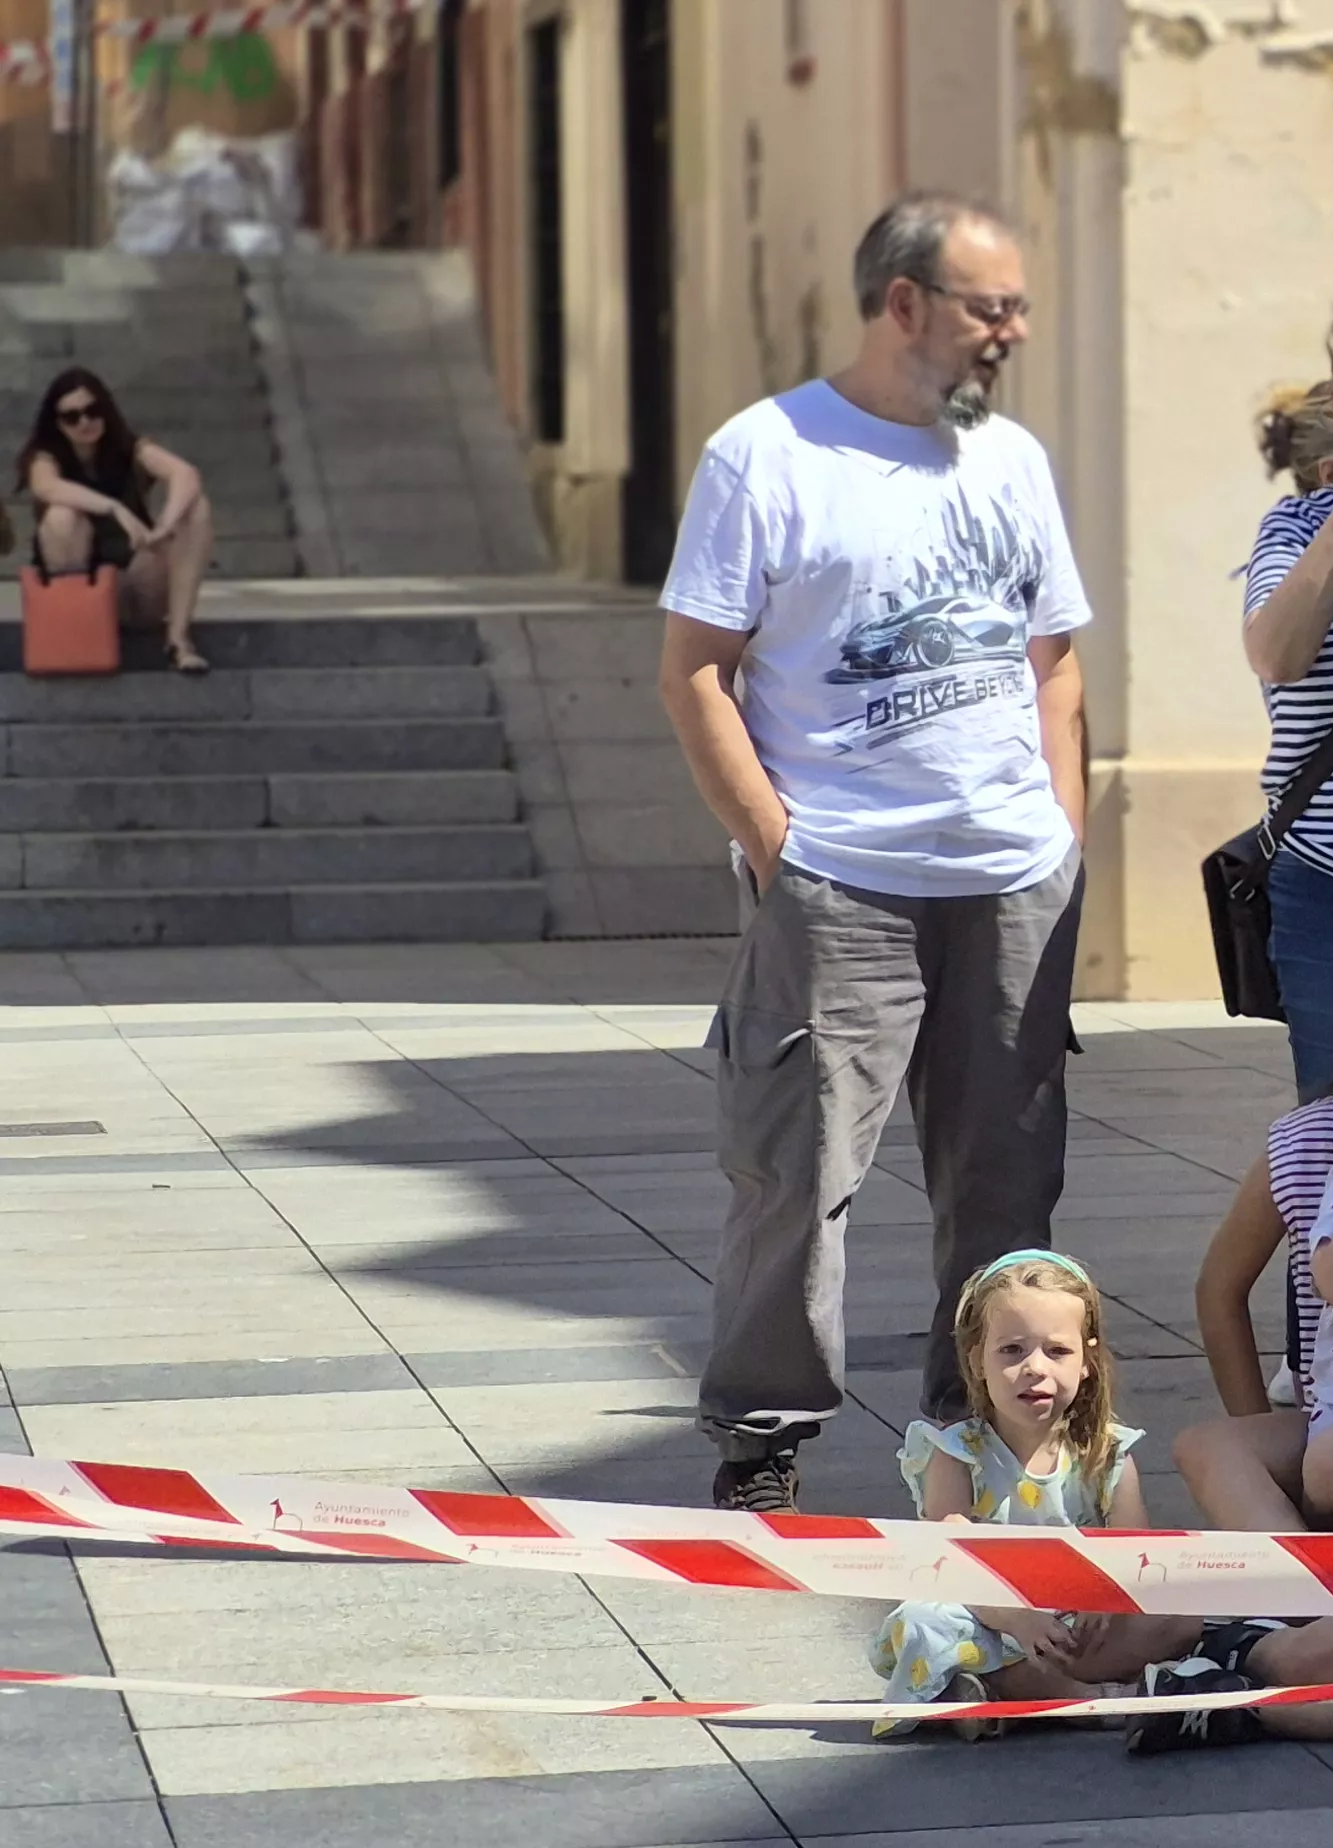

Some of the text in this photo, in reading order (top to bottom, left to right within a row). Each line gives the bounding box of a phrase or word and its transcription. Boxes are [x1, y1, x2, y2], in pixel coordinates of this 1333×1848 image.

[866, 680, 967, 729] DRIVE
[314, 1501, 410, 1518] Ayuntamiento
[313, 1515, 386, 1528] de Huesca
[1196, 1561, 1246, 1569] Huesca
